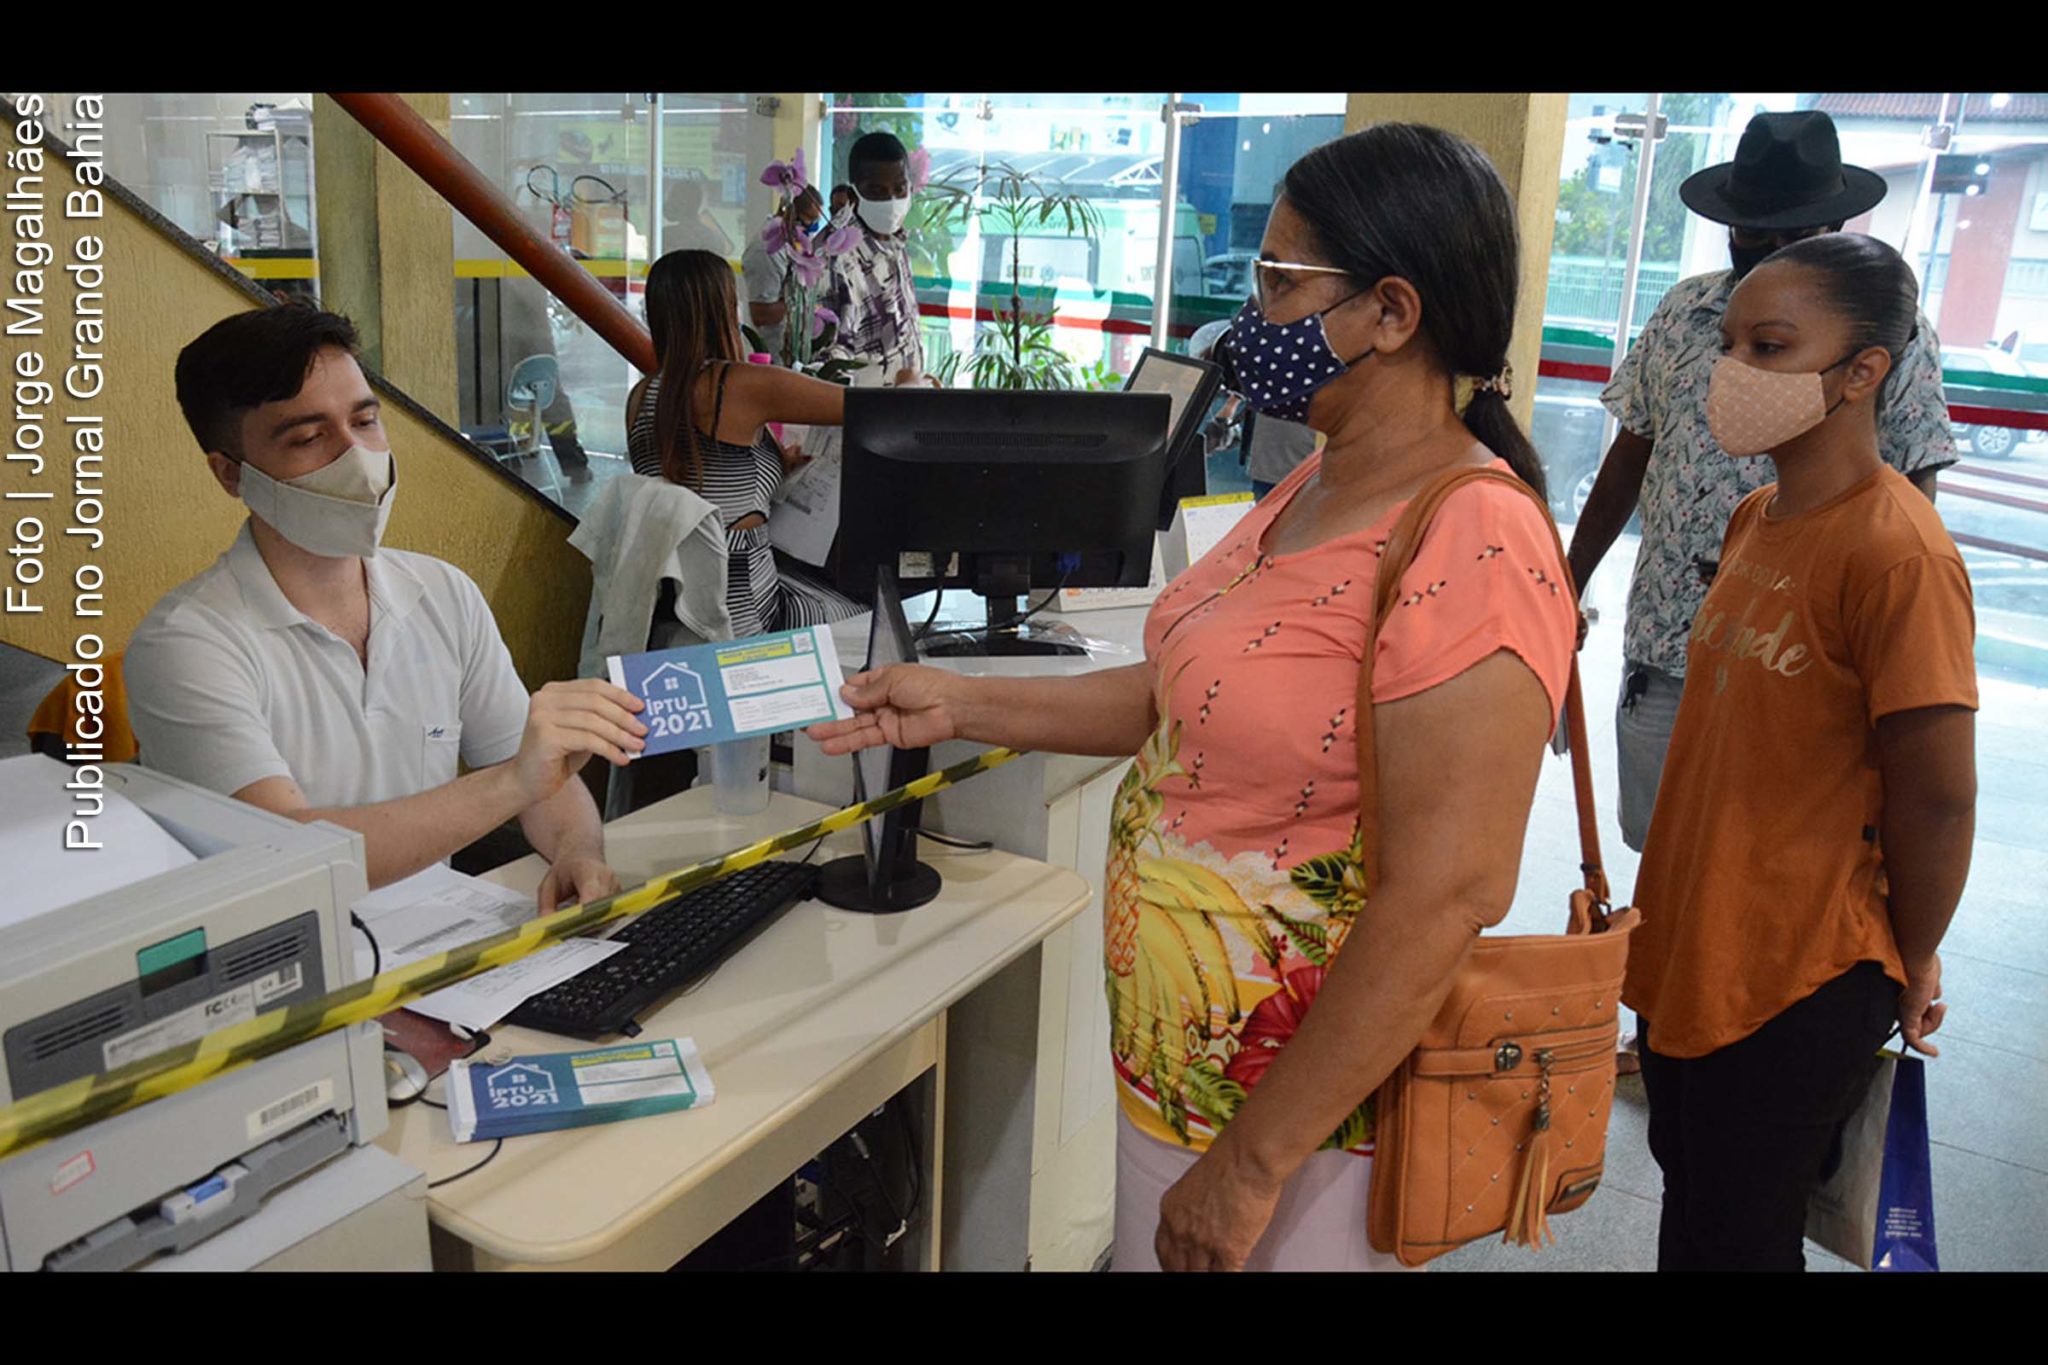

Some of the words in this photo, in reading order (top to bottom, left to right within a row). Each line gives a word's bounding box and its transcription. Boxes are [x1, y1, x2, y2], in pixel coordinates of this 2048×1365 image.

[646, 696, 688, 716] IPTU
[651, 709, 713, 737] 2021
[489, 1085, 534, 1099] IPTU
[492, 1092, 559, 1109] 2021
